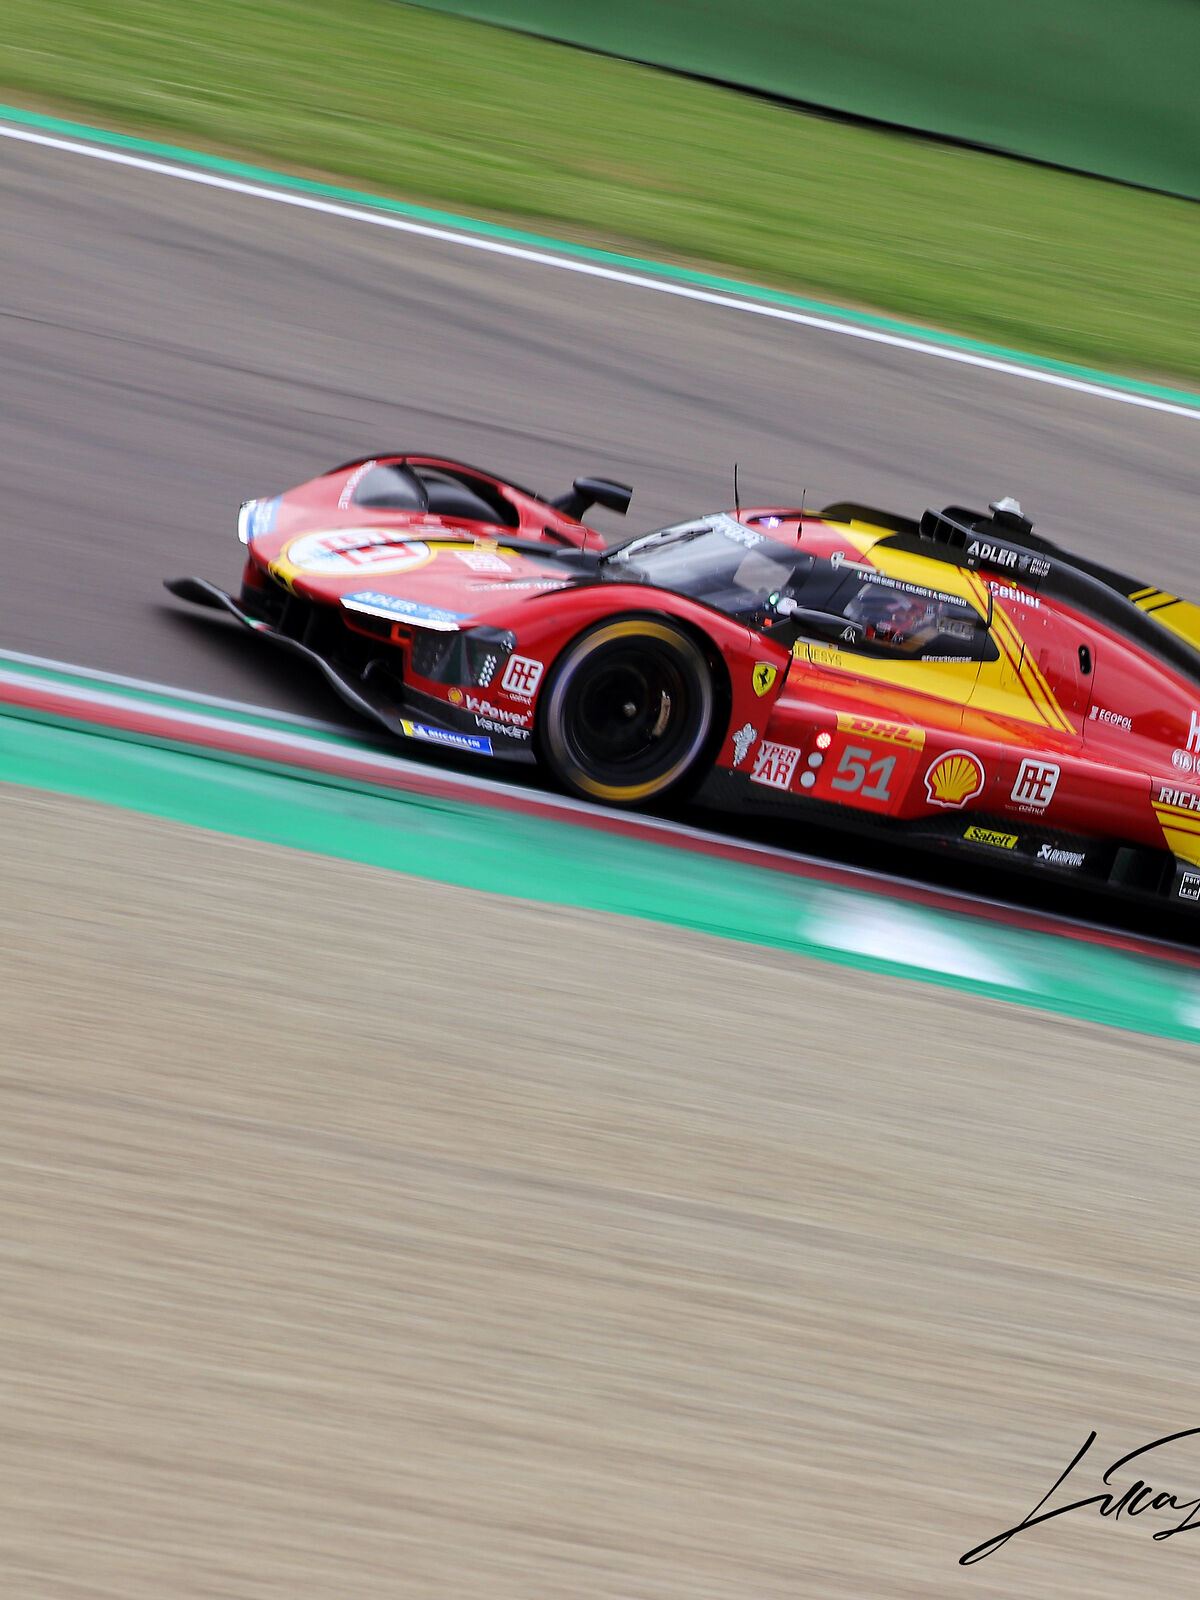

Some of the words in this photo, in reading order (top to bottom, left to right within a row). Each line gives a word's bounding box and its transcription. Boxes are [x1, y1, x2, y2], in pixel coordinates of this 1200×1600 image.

[966, 540, 1018, 568] ADLER
[850, 717, 912, 743] DHL
[831, 745, 897, 801] 51
[970, 827, 1012, 846] Sabelt
